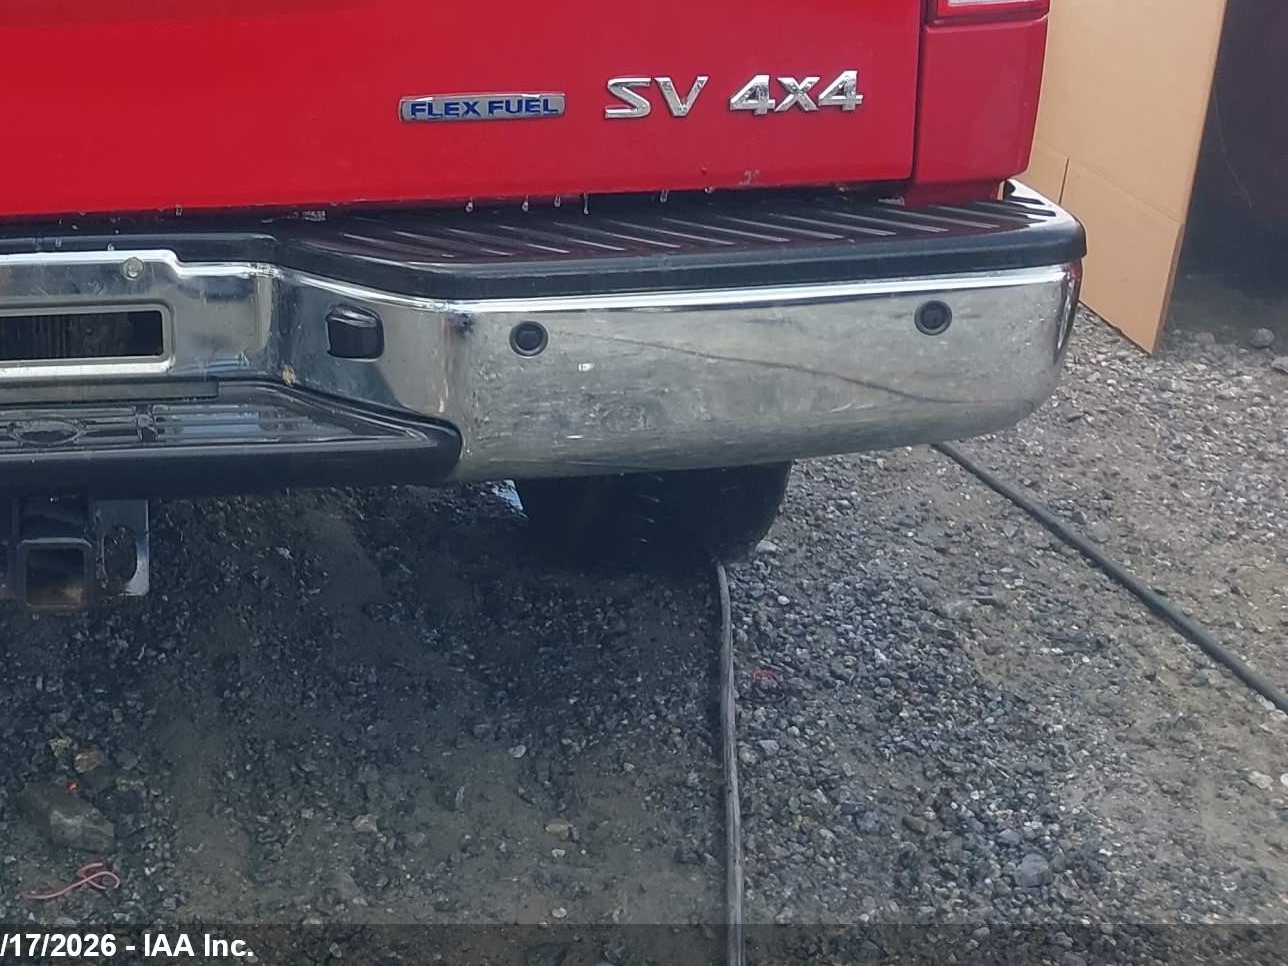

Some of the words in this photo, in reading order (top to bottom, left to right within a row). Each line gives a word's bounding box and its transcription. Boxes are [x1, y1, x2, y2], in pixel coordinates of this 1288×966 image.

[410, 100, 482, 120] FLEX
[487, 97, 559, 117] FUEL
[604, 75, 710, 119] SV
